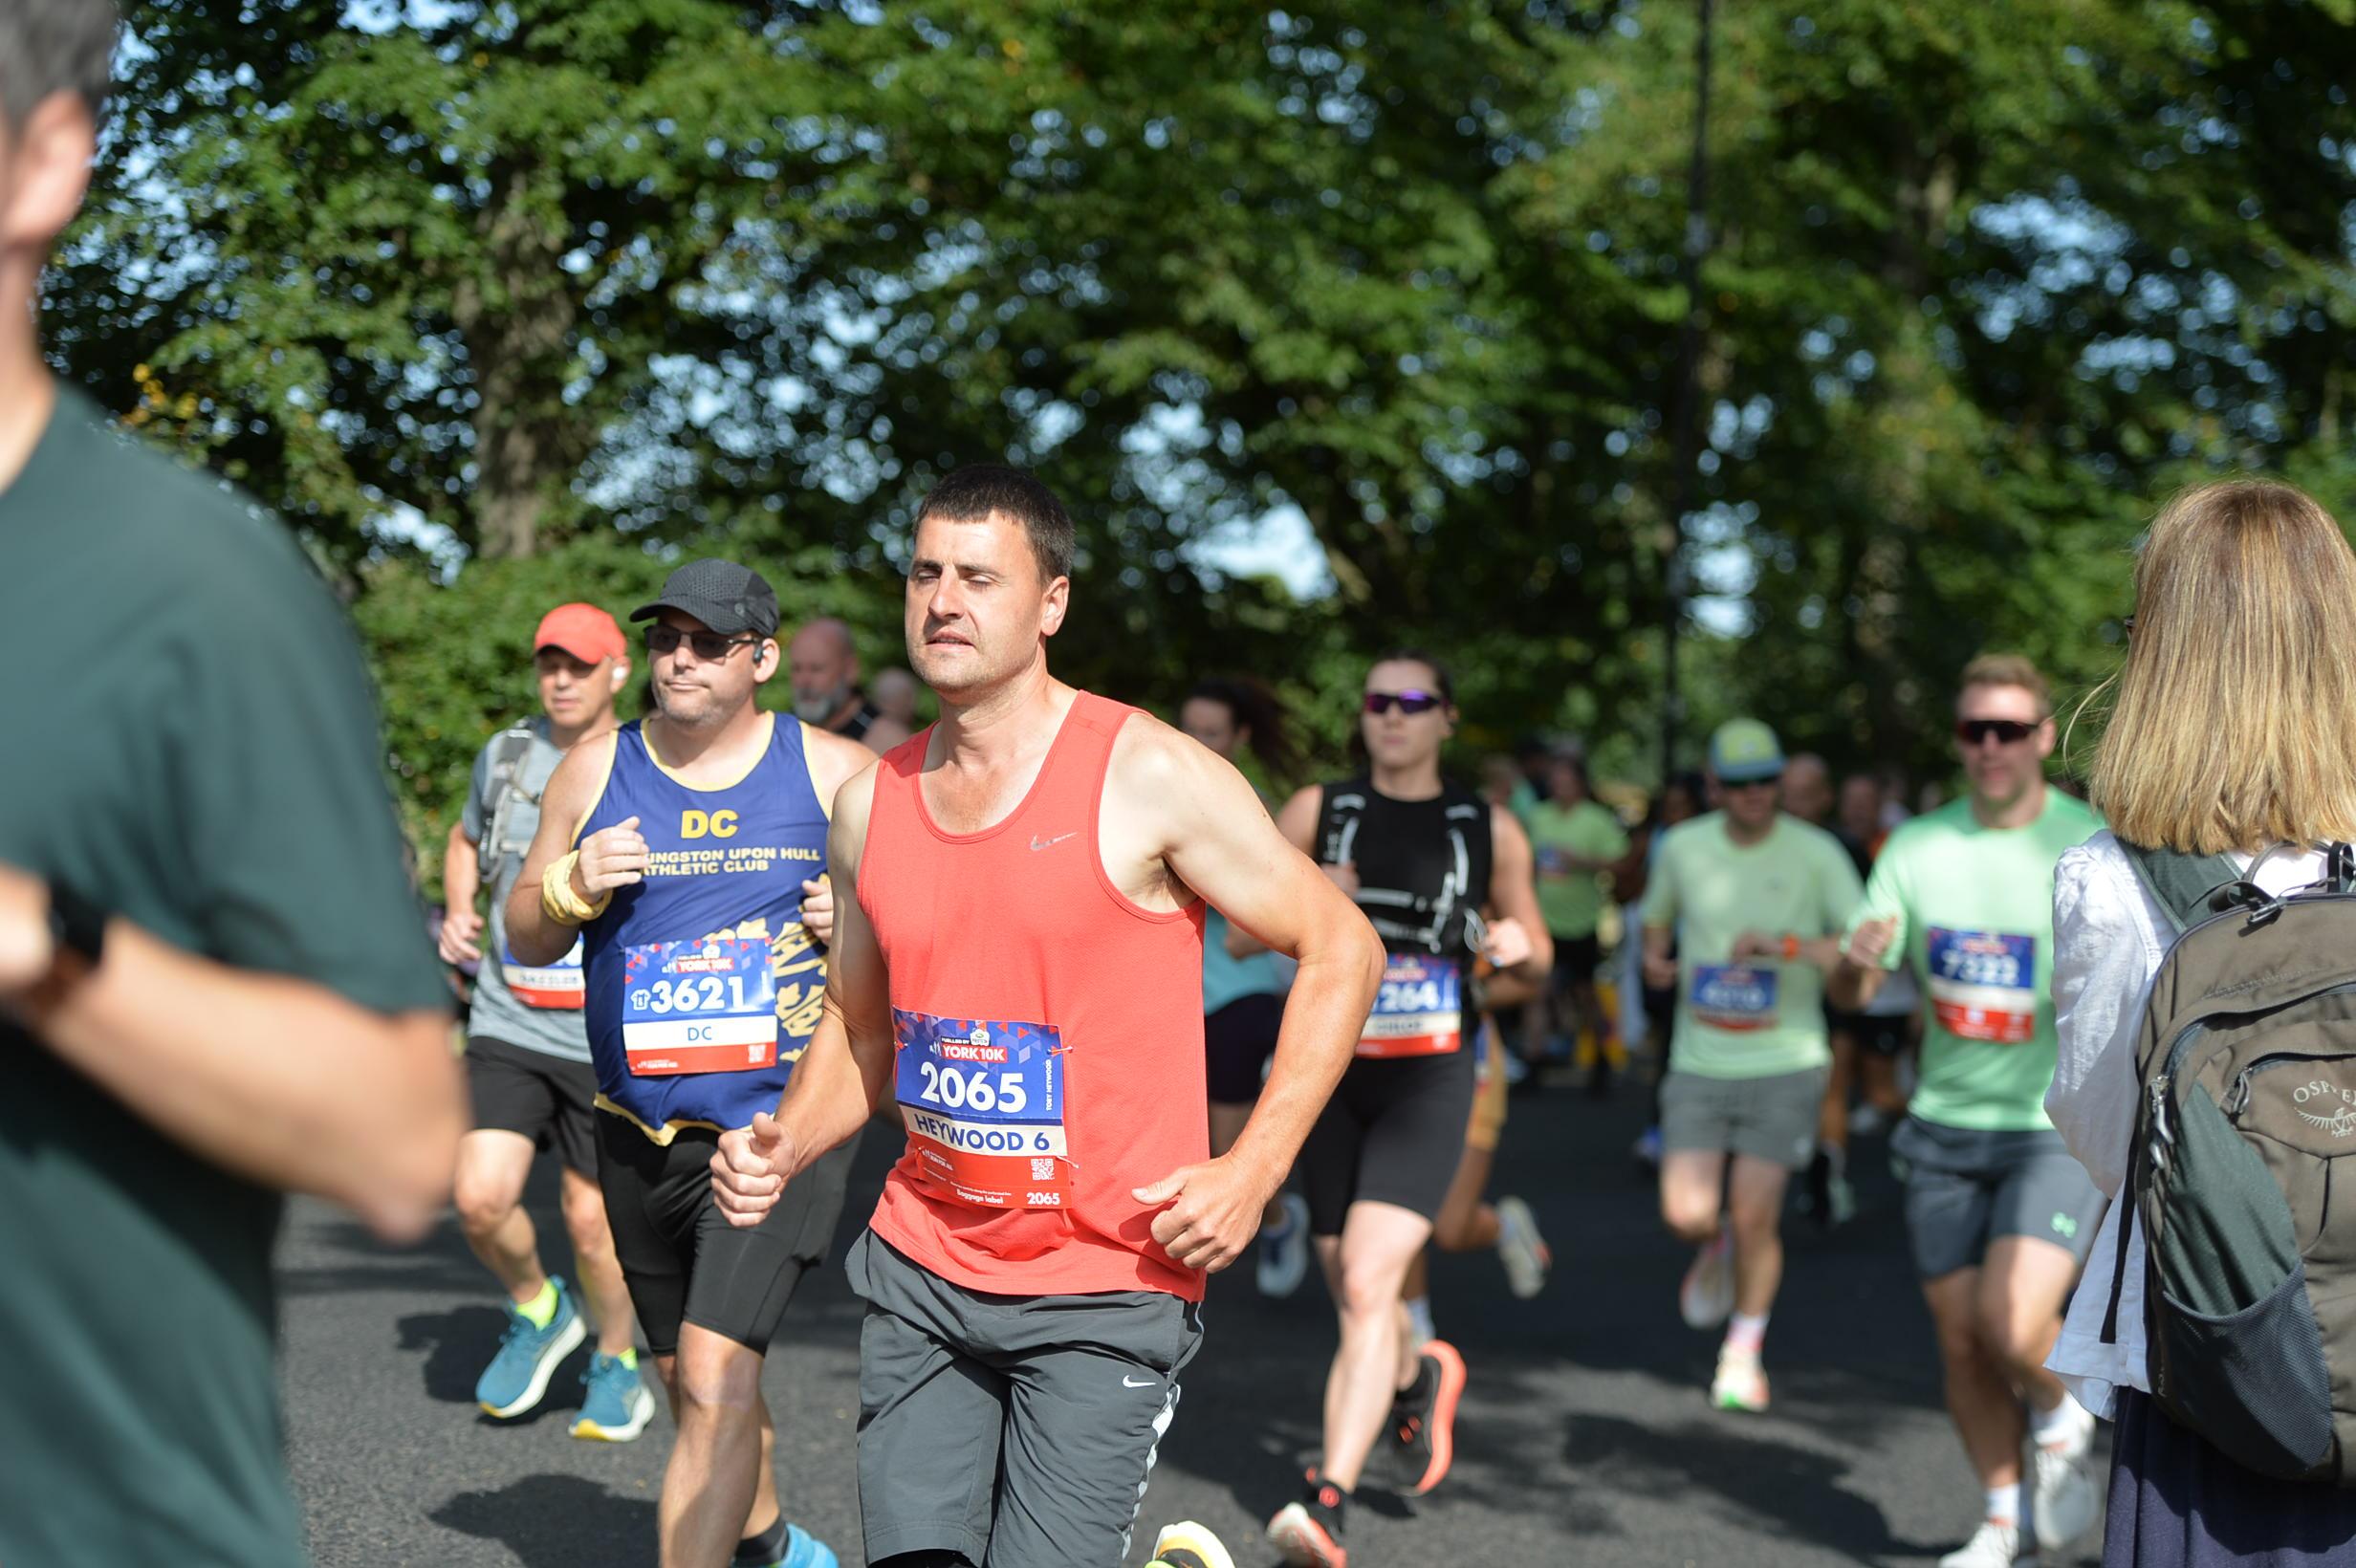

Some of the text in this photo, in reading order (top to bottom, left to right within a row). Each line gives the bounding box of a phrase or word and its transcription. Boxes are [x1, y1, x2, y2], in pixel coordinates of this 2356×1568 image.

[680, 809, 739, 839] DC
[645, 847, 820, 863] INGSTON UPON HULL
[723, 860, 769, 873] CLUB
[650, 976, 744, 1013] 3621
[1372, 980, 1439, 1012] 264
[687, 1026, 712, 1041] DC
[943, 1045, 1005, 1060] YORK 10K
[920, 1061, 1027, 1113] 2065
[2293, 1079, 2356, 1106] OSPE
[915, 1114, 1050, 1151] HEYWOOD 6
[984, 1195, 1003, 1204] label
[1026, 1192, 1060, 1205] 2065
